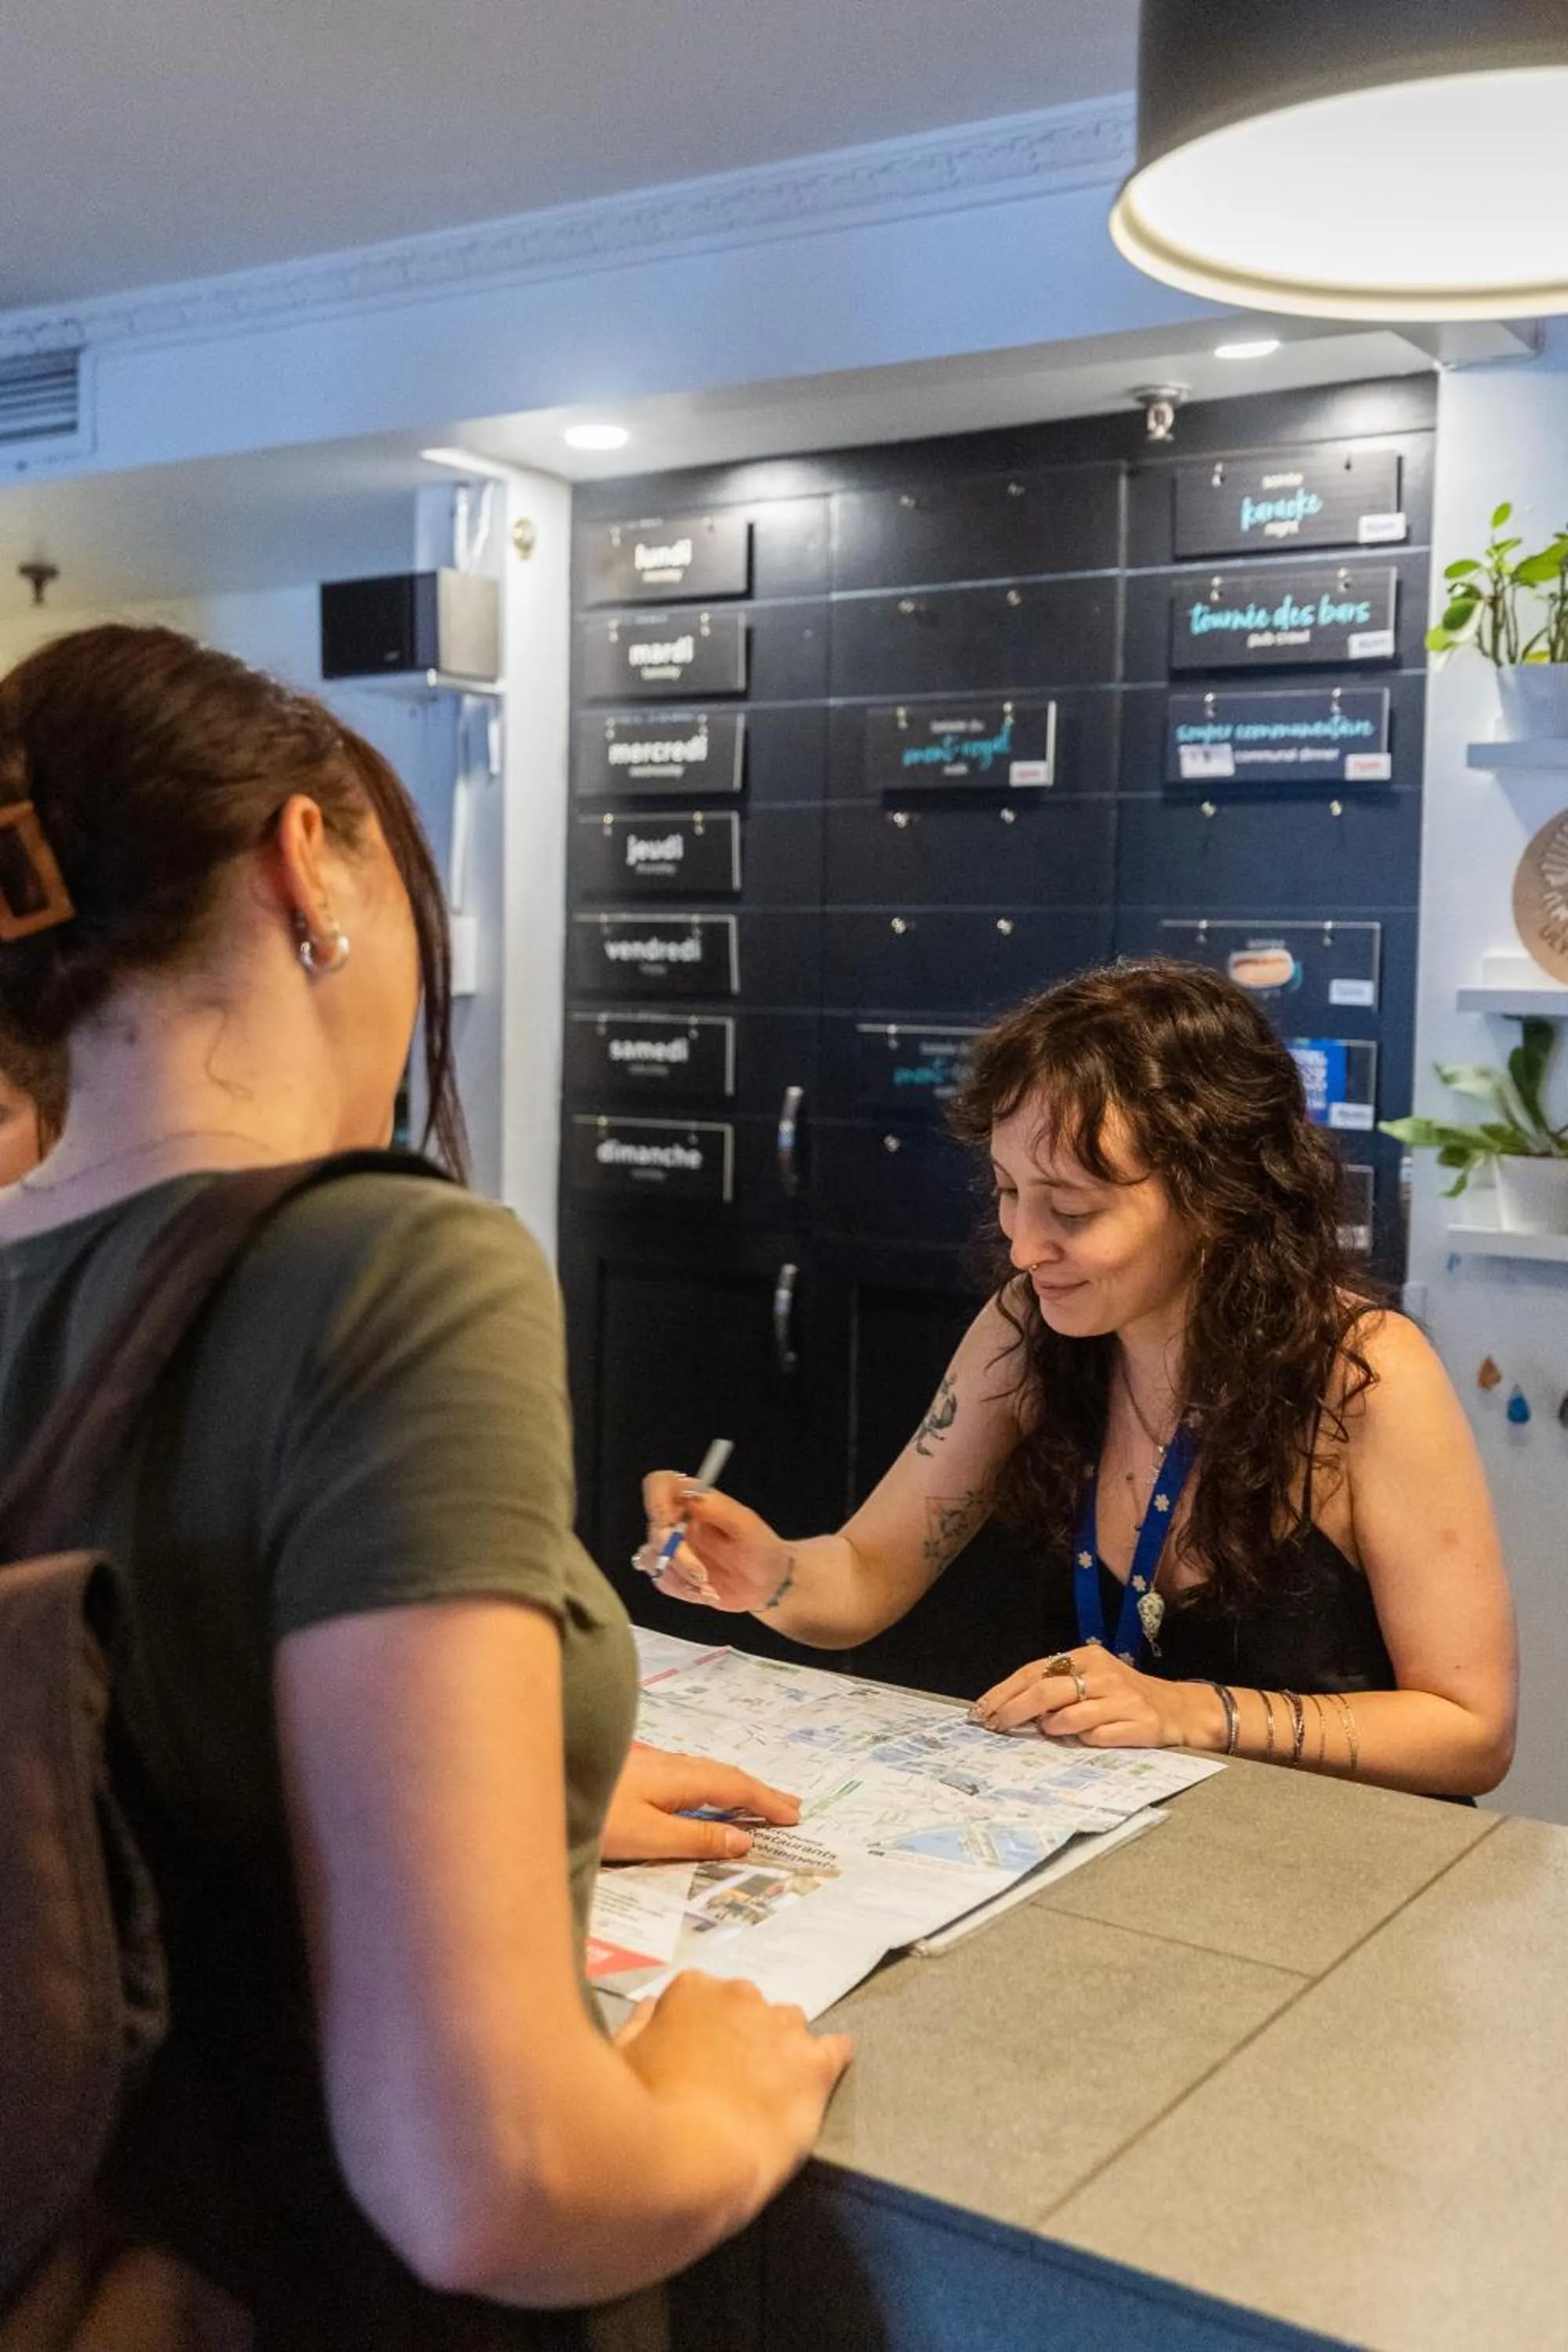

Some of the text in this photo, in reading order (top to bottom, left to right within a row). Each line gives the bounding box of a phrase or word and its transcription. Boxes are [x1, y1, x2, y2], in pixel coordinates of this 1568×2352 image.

[1240, 487, 1323, 532] karaoke
[635, 539, 693, 570] lundi
[1272, 593, 1315, 630] des
[1317, 593, 1370, 626] bars
[629, 635, 694, 666] mardi
[608, 735, 708, 764] mercredi
[626, 833, 684, 866] jeudi
[604, 936, 702, 962] vendredi
[609, 1036, 689, 1063] samedi
[596, 1138, 703, 1170] dimanche
